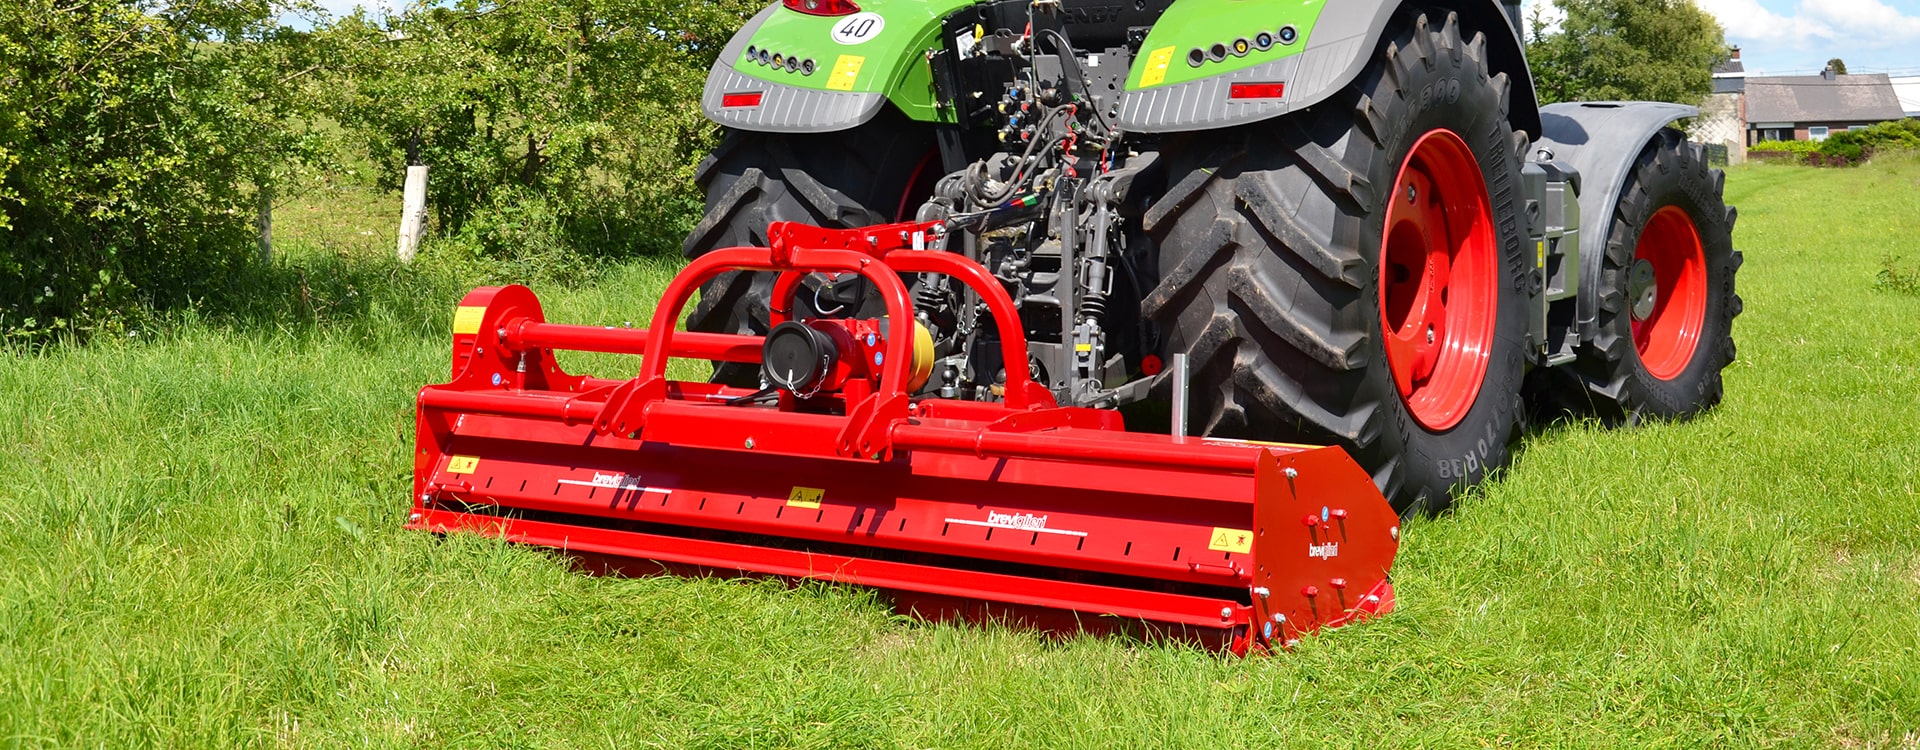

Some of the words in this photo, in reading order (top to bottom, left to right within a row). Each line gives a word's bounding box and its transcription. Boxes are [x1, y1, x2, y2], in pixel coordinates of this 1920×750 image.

[840, 18, 875, 38] 40
[1489, 119, 1527, 296] TRELLEBORG
[987, 510, 1048, 530] breviglieri
